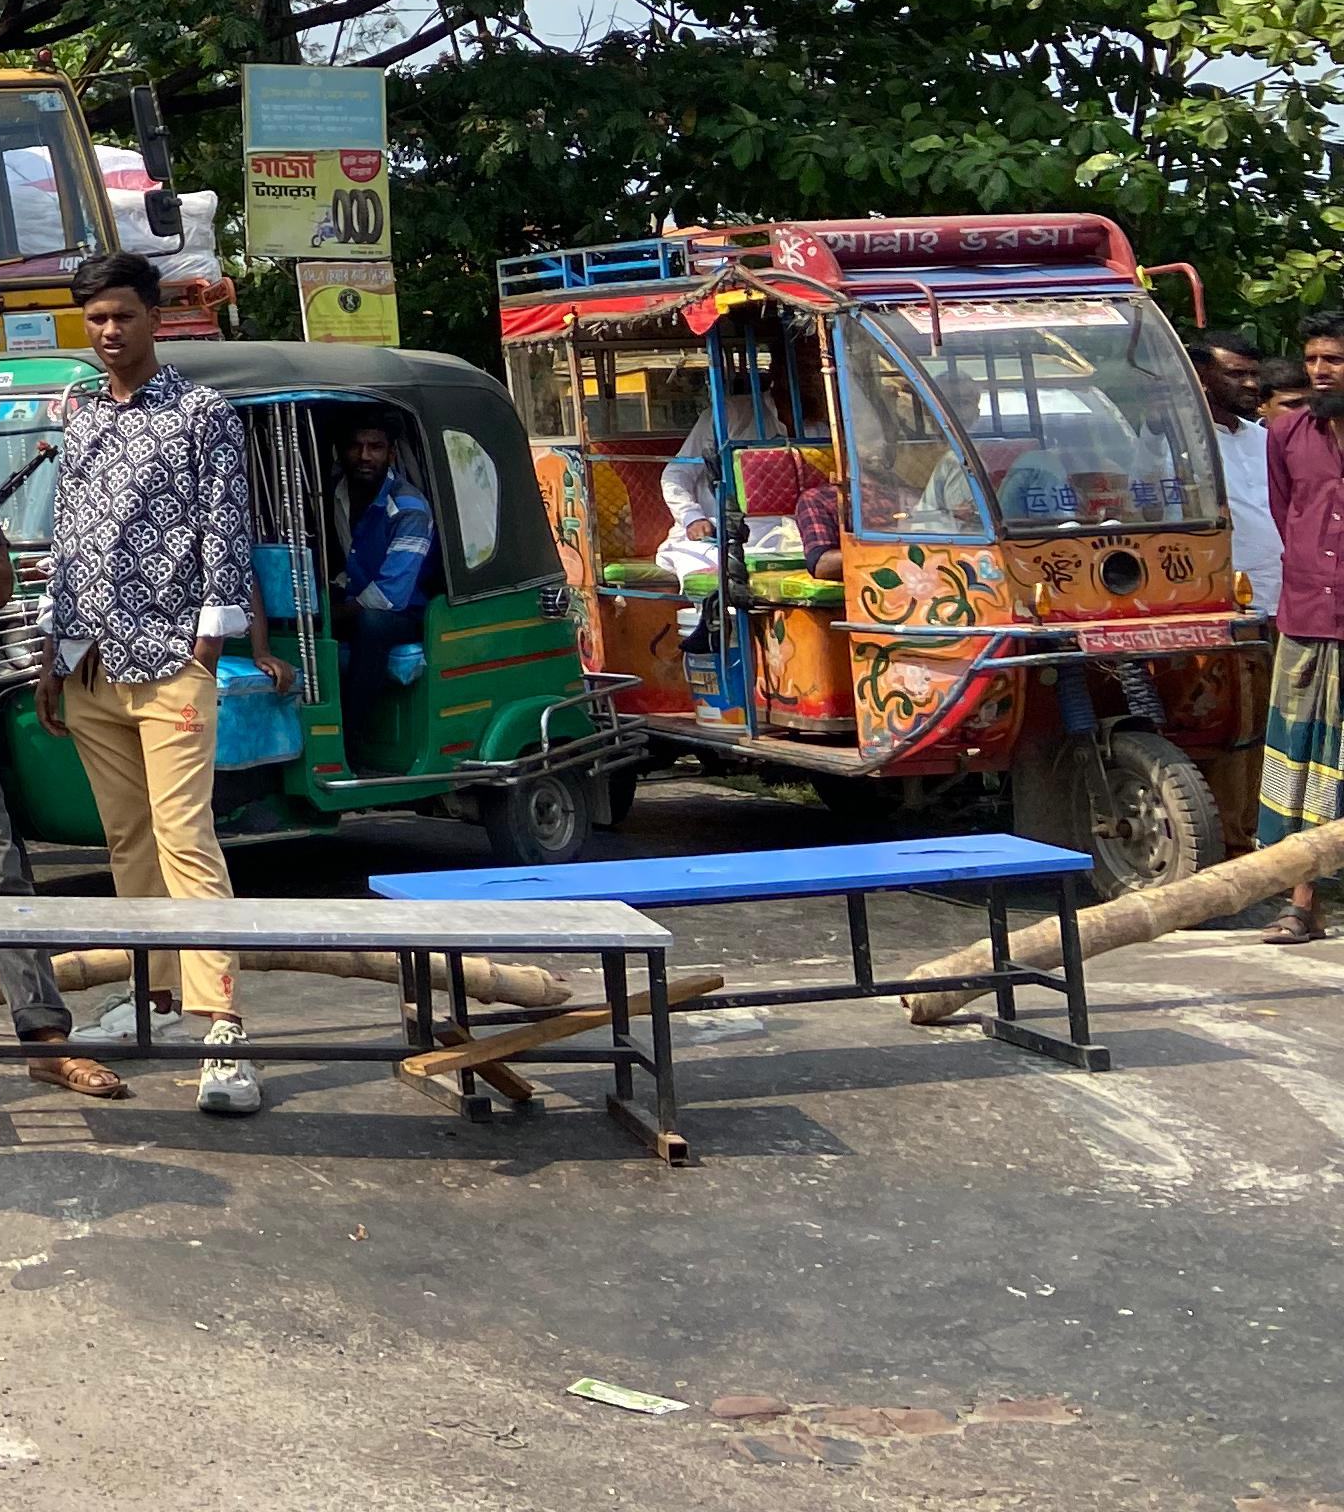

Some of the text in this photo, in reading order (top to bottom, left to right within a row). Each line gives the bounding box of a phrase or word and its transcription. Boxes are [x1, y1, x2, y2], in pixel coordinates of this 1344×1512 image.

[251, 154, 317, 179] গাজী
[816, 223, 1082, 256] আল্লাহ ভরসা
[1130, 477, 1189, 508] 集团
